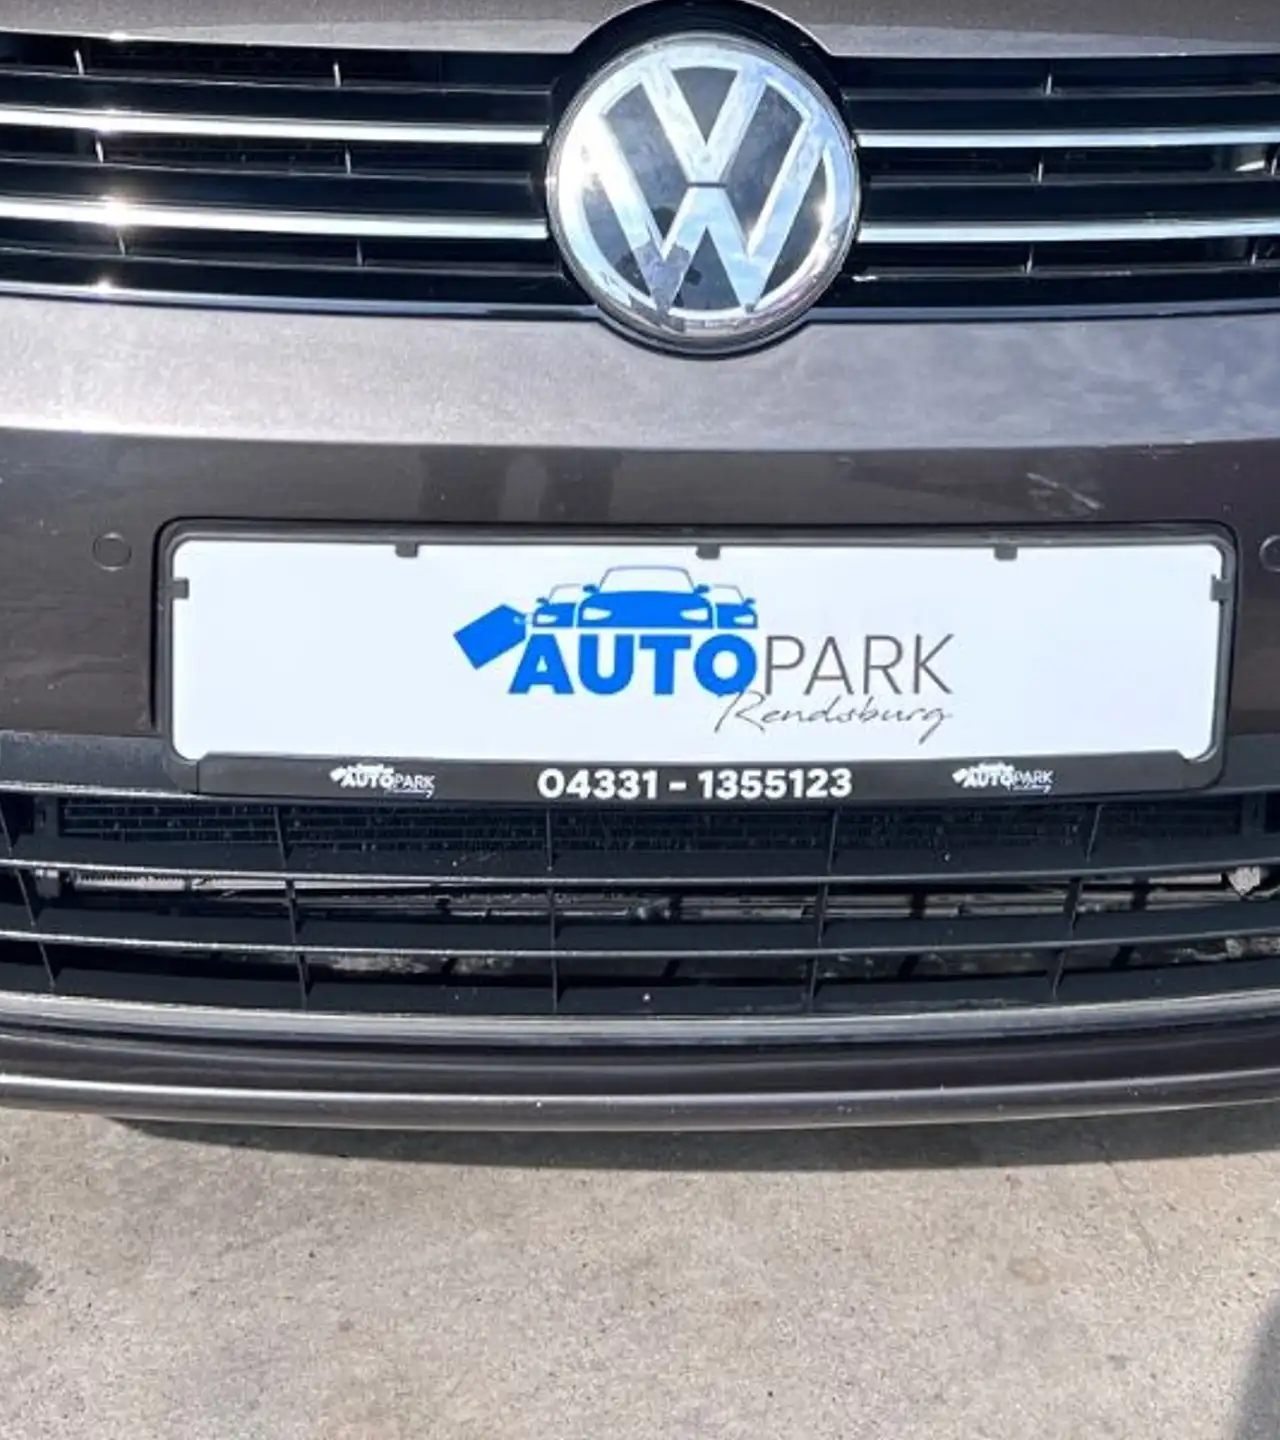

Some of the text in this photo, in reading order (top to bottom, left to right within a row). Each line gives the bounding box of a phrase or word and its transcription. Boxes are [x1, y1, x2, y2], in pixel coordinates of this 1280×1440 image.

[565, 55, 835, 318] VW
[508, 633, 955, 697] AUTOPARK
[714, 690, 953, 745] Rendsburg
[537, 767, 658, 800] 04331
[697, 767, 853, 800] 1355123
